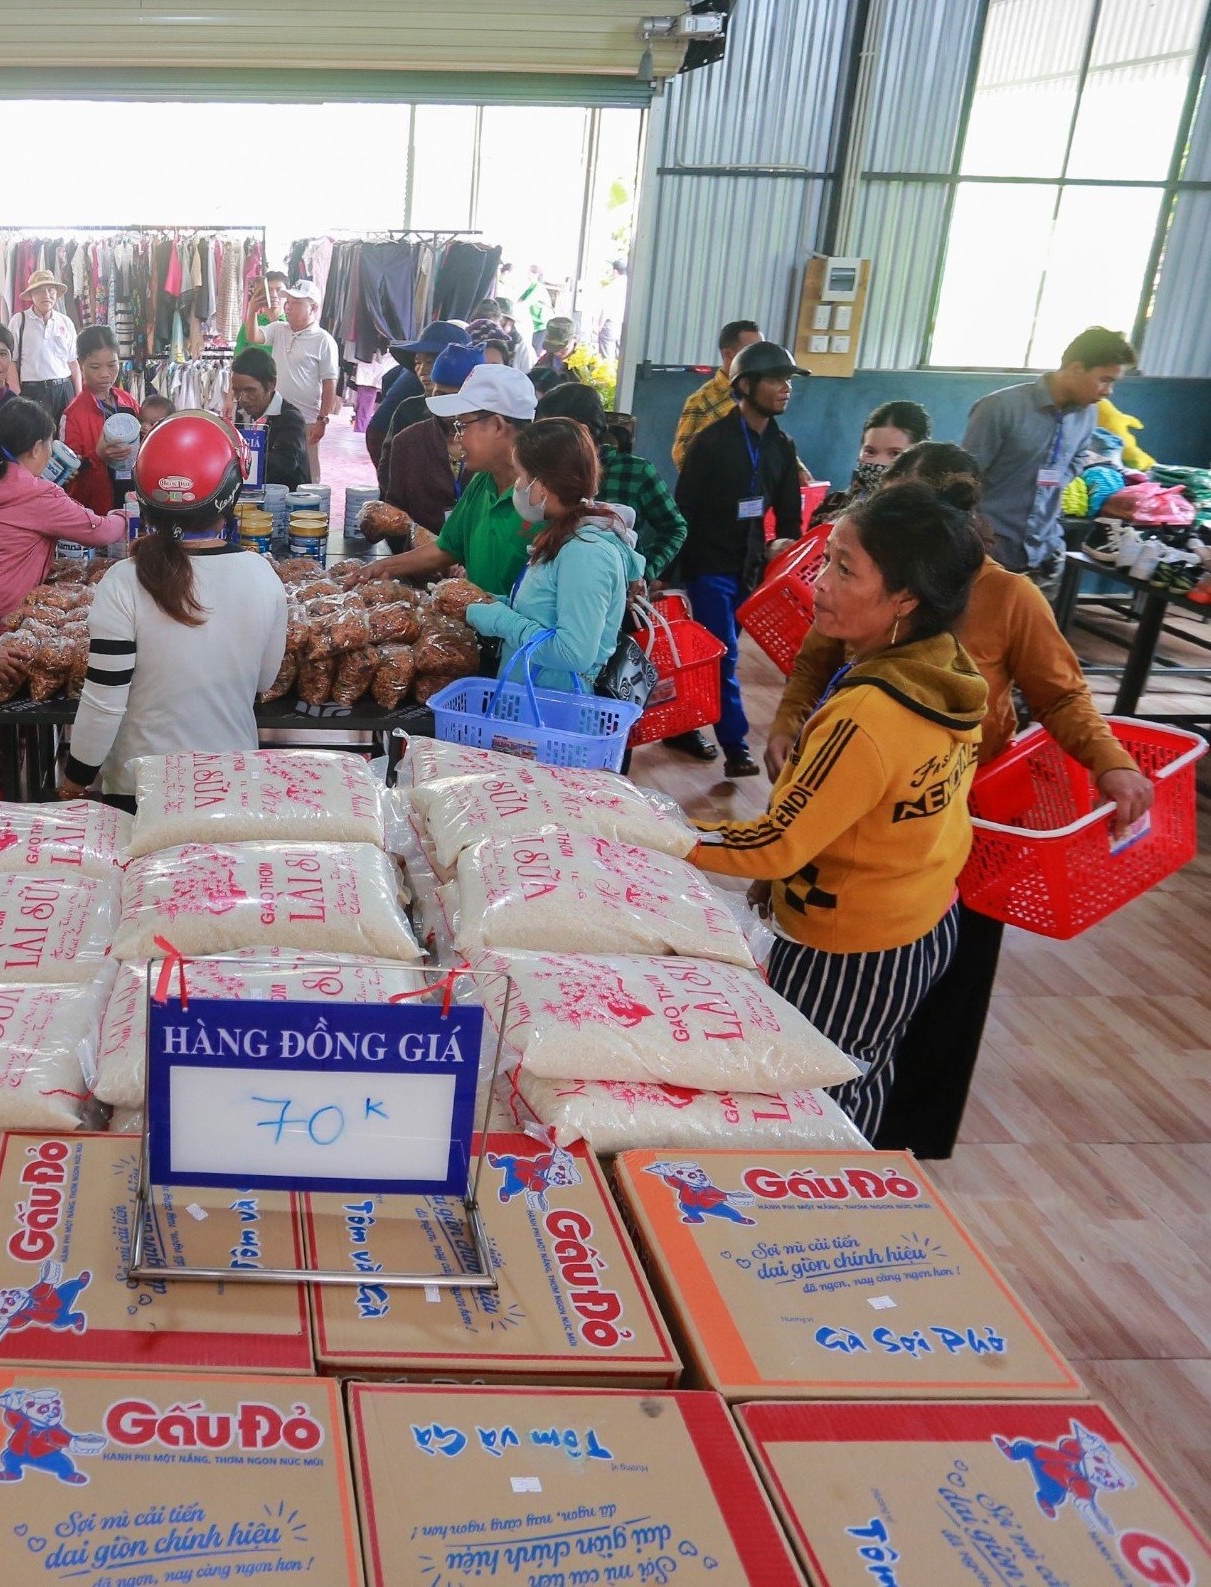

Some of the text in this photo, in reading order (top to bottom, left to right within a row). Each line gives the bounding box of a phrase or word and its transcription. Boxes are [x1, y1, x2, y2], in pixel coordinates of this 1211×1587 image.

[277, 877, 326, 924] LÀI
[680, 988, 745, 1041] LÀI
[163, 1016, 464, 1063] HÀNG ĐỒNG GIÁ
[251, 1096, 344, 1145] 70
[9, 1142, 68, 1261] Gấu Đỏ
[744, 1169, 918, 1198] Gấu Đỏ
[344, 1200, 375, 1243] Tôm
[752, 1234, 860, 1260] Sợi mì cải tiến
[757, 1245, 927, 1280] dai giòn chính hiệu
[545, 1210, 632, 1347] Gấu Đỏ
[803, 1282, 818, 1294] đã
[853, 1275, 875, 1287] nay
[876, 1271, 902, 1284] càng
[904, 1268, 933, 1281] ngon
[815, 1325, 1006, 1358] Gà Sợi Phở
[106, 1401, 321, 1450] Gấu Đỏ
[411, 1423, 613, 1459] Tôm và Gà
[55, 1501, 205, 1538] Sợi mì cải tiến
[451, 1522, 486, 1535] ngon
[491, 1519, 522, 1533] càng
[526, 1513, 553, 1525] nay
[45, 1522, 281, 1570] dai giòn chính hiệu
[445, 1524, 672, 1576] dai giòn chính hiệu
[164, 1568, 193, 1583] nay
[196, 1561, 231, 1580] càng
[235, 1560, 274, 1576] ngon
